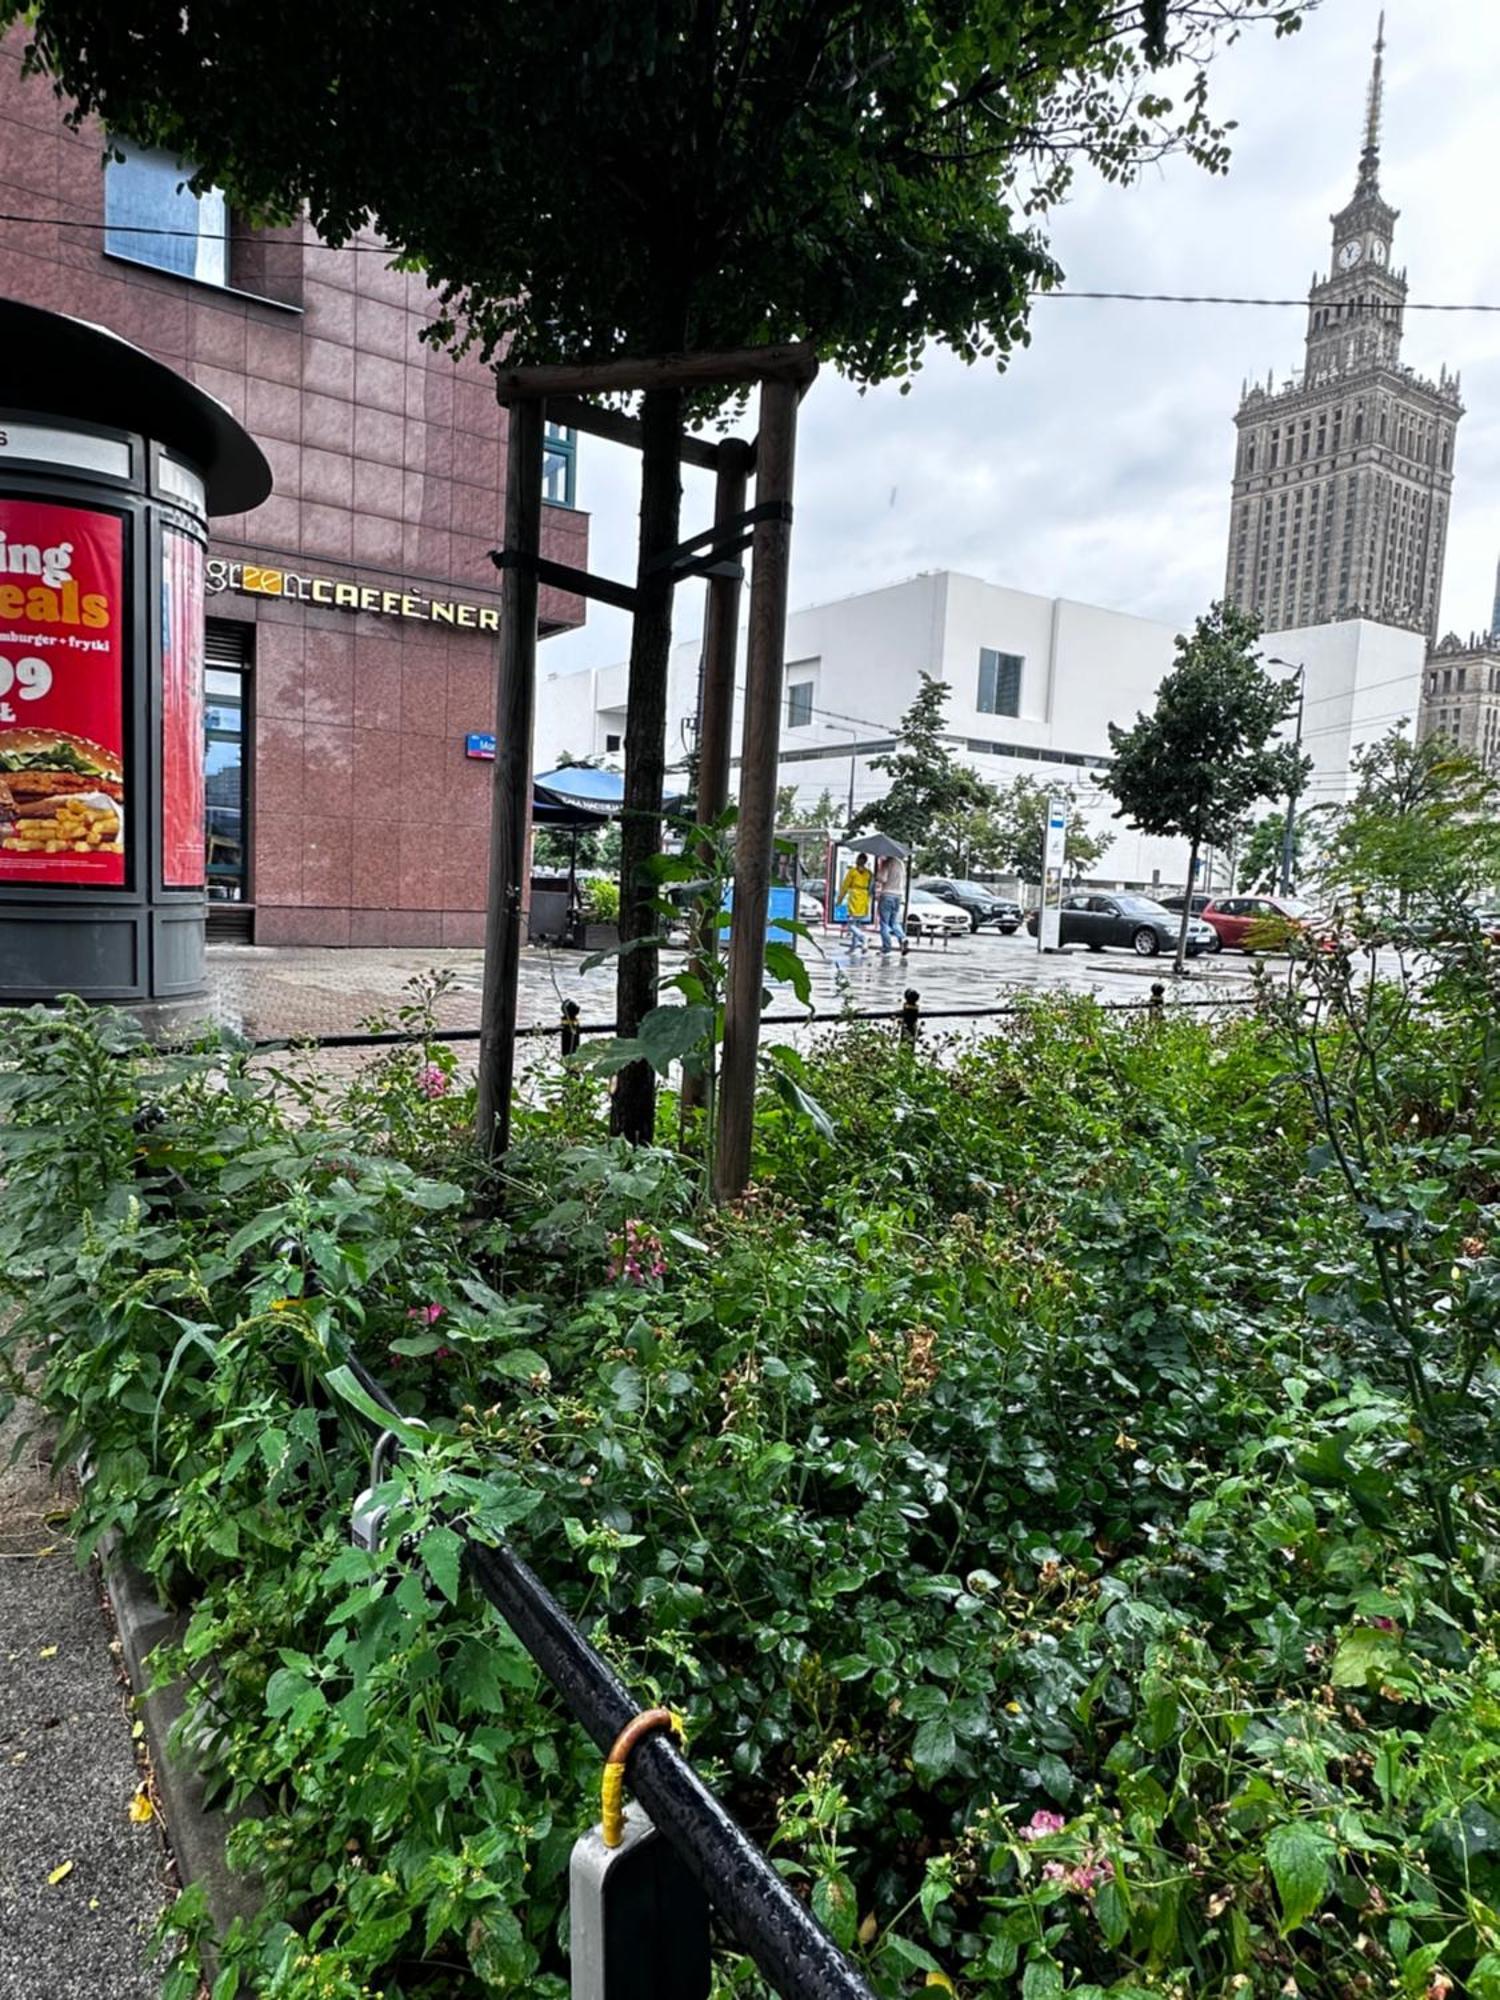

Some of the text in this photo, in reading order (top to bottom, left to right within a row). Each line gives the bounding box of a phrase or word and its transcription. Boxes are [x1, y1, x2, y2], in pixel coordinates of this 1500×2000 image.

[206, 560, 312, 600] green
[431, 600, 499, 630] NER
[68, 635, 110, 652] frytki
